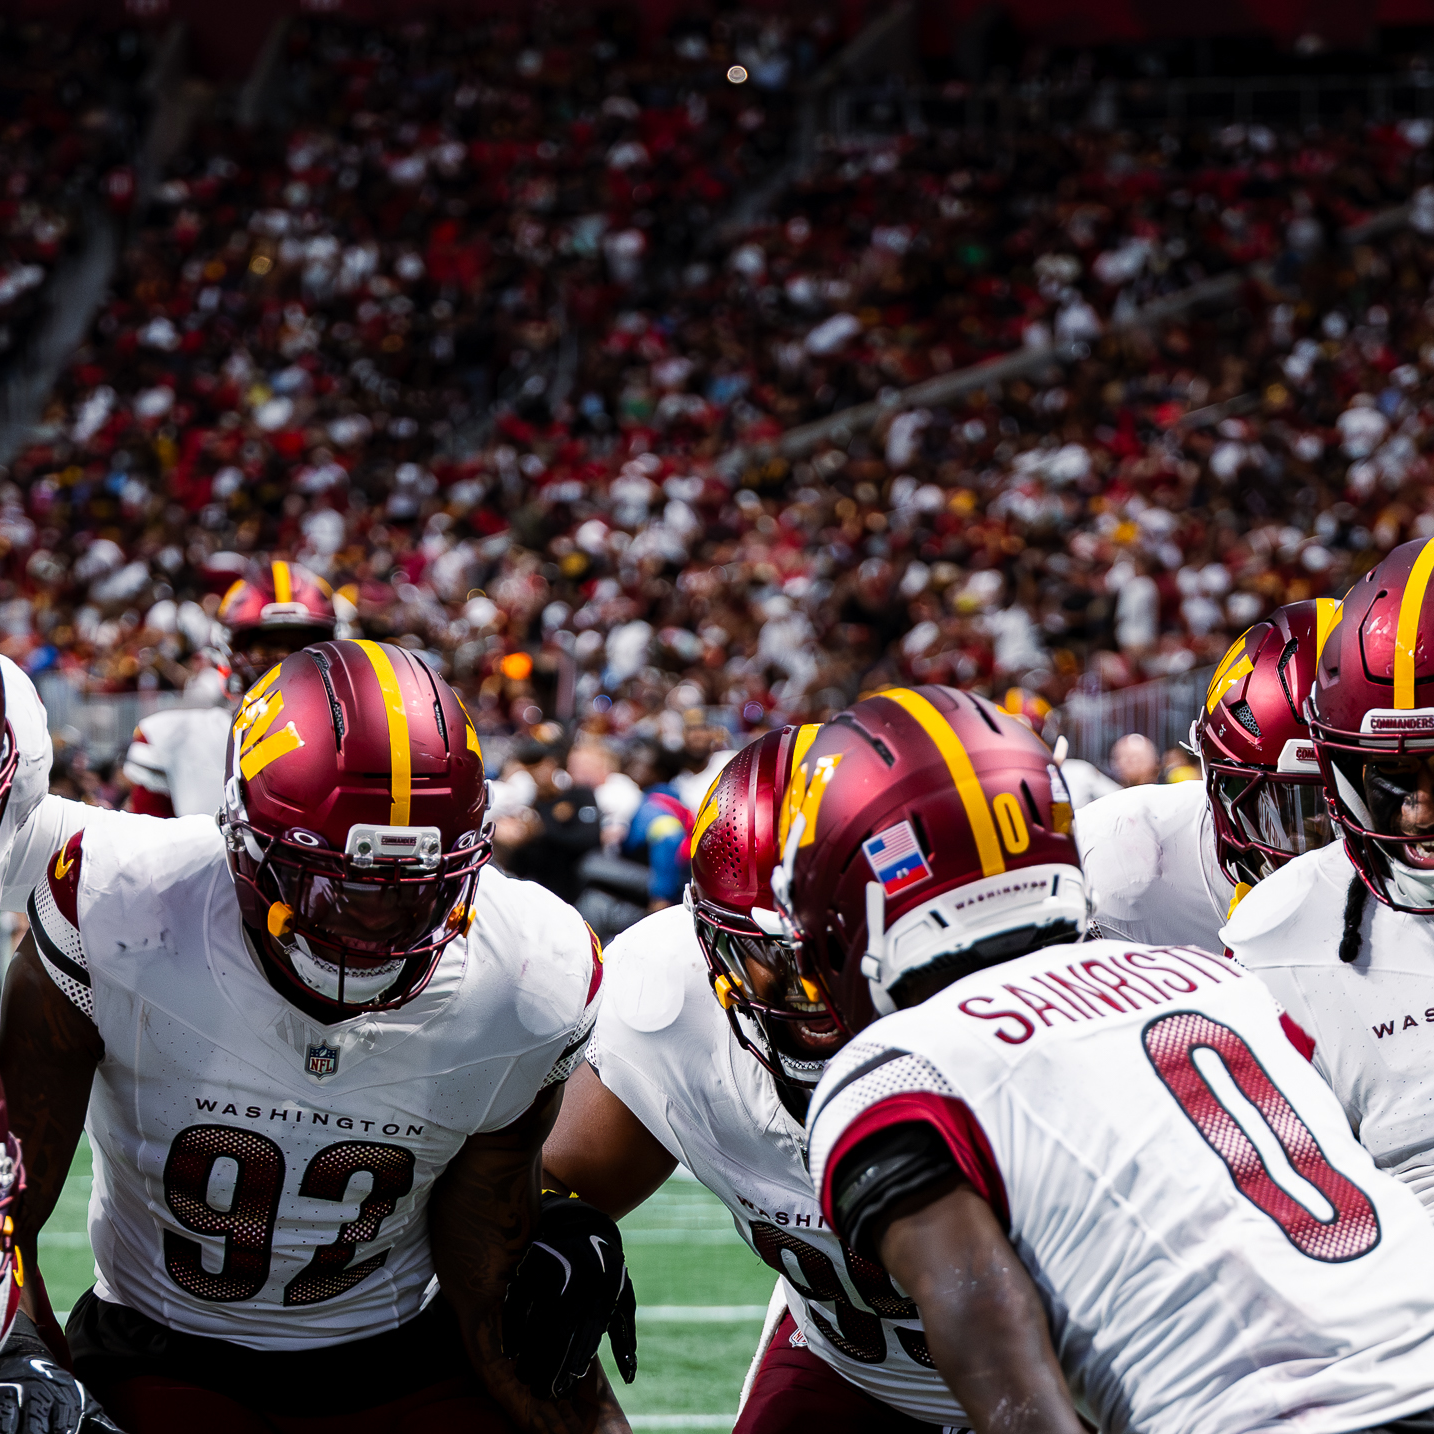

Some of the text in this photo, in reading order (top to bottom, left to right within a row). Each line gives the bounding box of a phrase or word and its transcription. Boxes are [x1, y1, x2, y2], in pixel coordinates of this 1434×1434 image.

[992, 792, 1030, 855] 0
[954, 880, 1048, 911] WASHINGTON
[309, 1057, 334, 1073] NFL
[194, 1096, 426, 1138] WASHINGTON
[1142, 1009, 1382, 1263] 0
[163, 1123, 417, 1307] 92
